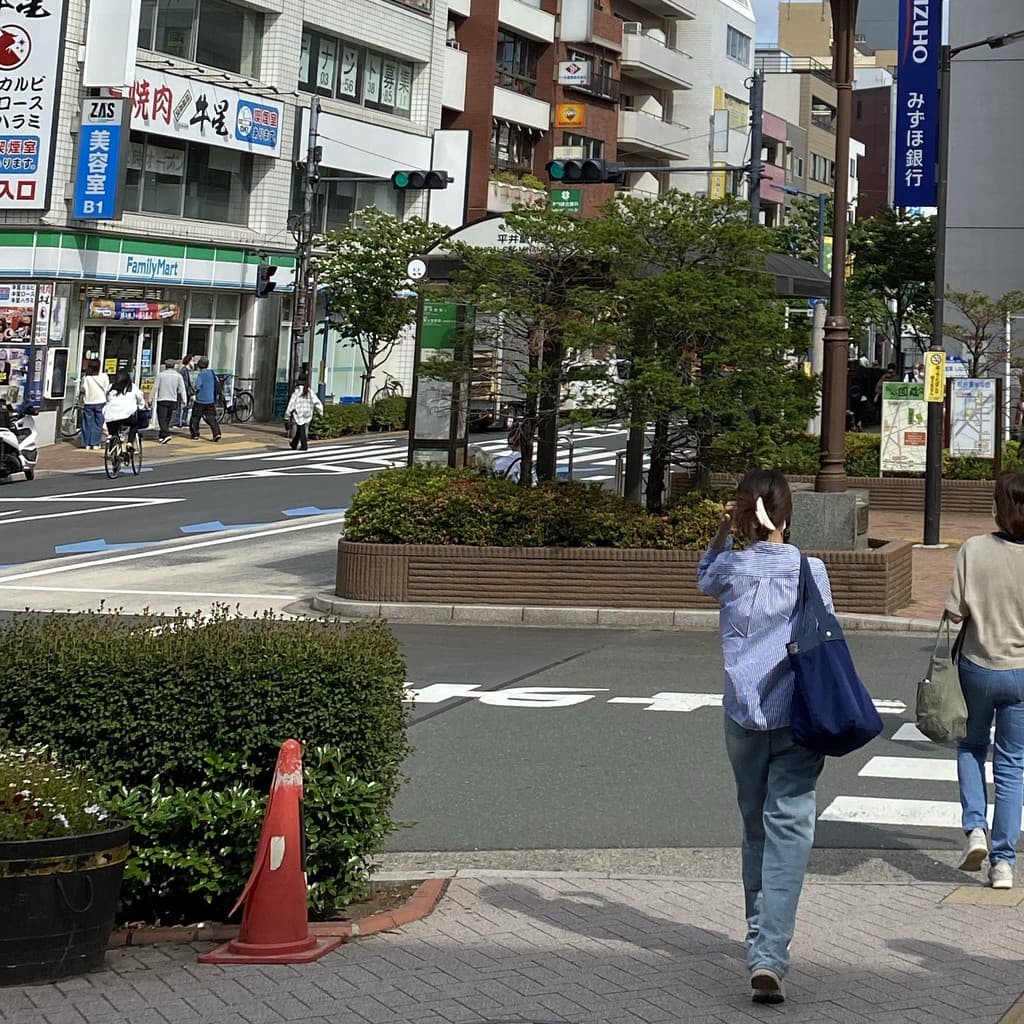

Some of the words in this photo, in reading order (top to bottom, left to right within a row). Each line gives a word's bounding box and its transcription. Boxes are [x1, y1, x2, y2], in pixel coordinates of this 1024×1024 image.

[90, 102, 115, 119] ZAS
[131, 78, 173, 125] 焼肉
[0, 140, 37, 154] 煙室
[905, 92, 925, 187] みずほ銀行
[85, 129, 111, 196] 美容室
[0, 180, 37, 201] 入口
[83, 200, 104, 214] B1
[126, 256, 179, 279] FamilyMart
